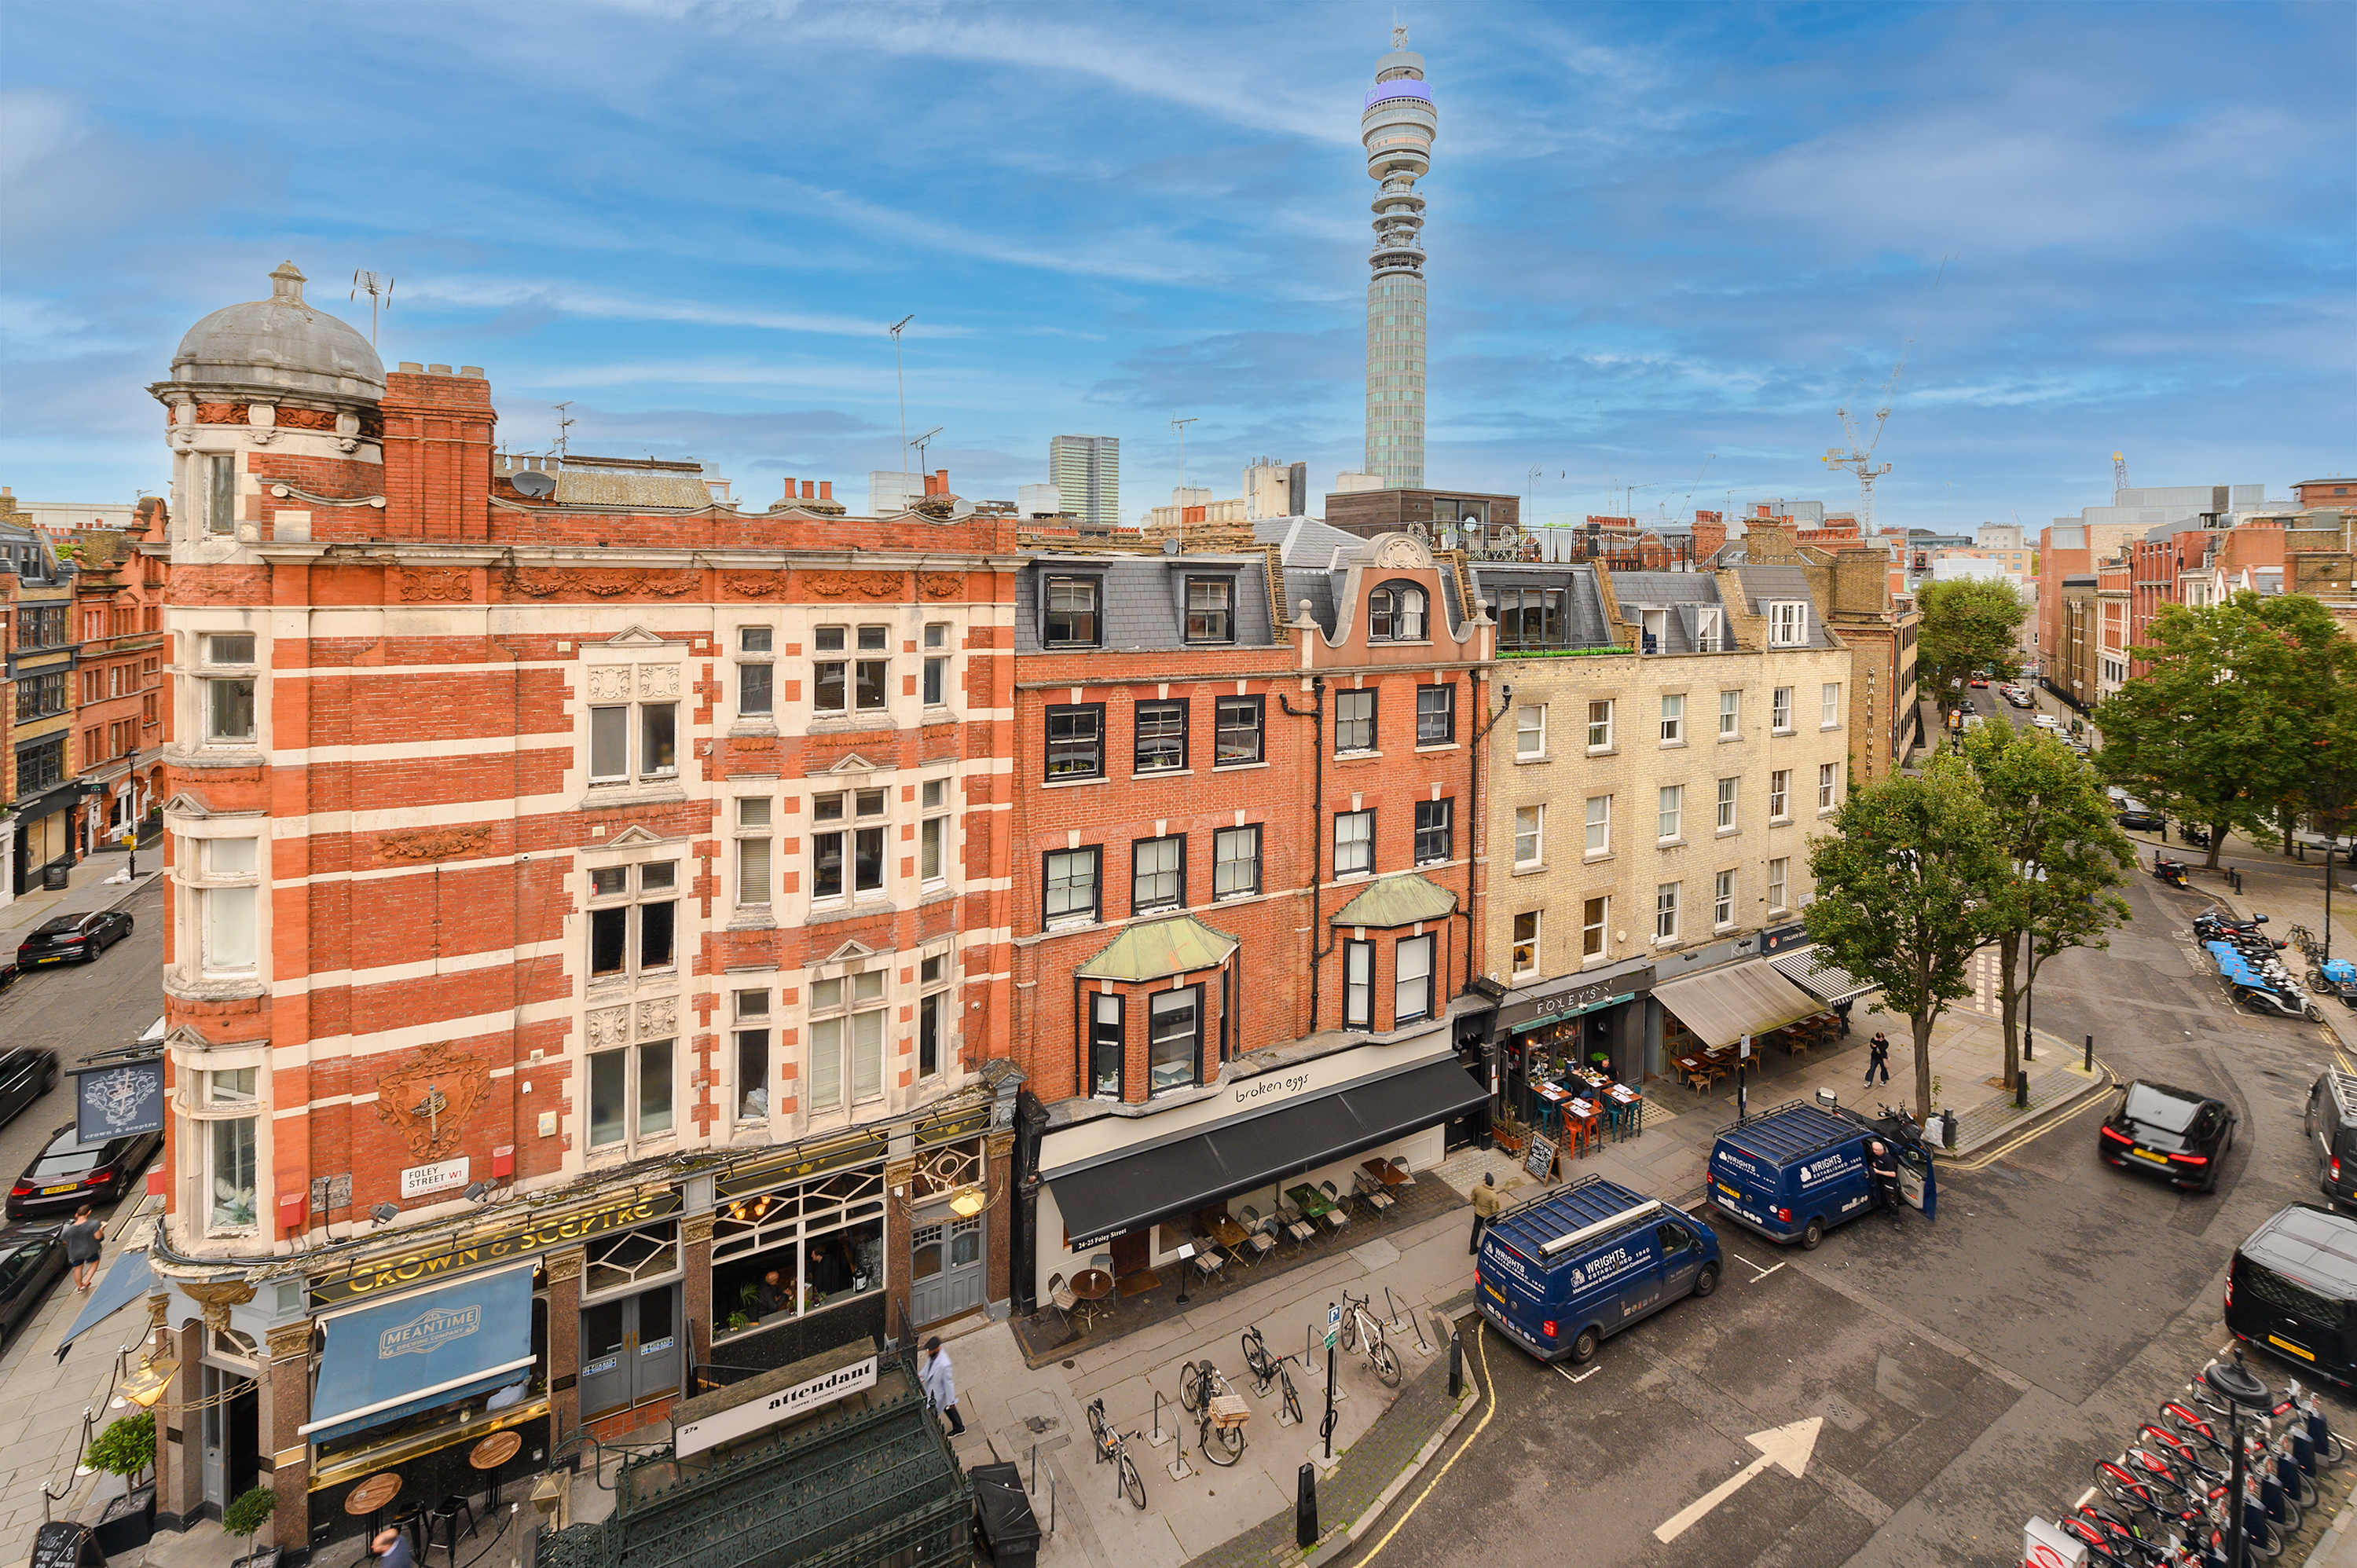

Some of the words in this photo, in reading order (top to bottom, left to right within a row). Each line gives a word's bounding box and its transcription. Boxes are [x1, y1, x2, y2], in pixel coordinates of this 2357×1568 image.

[1782, 932, 1800, 943] ITALIAN
[1537, 989, 1596, 1015] FOLEY'S
[1235, 1081, 1281, 1103] broken
[1285, 1073, 1309, 1092] eggs
[84, 1131, 112, 1140] crown
[125, 1122, 157, 1131] sceptre
[409, 1166, 438, 1179] FOLEY
[1726, 1153, 1757, 1172] WRIGHTS
[1809, 1154, 1842, 1174] WRIGHTS
[1813, 1162, 1848, 1178] ESTABLISHED
[409, 1174, 445, 1189] STREET
[449, 1170, 463, 1179] W1
[349, 1242, 478, 1292] CROWN
[489, 1234, 511, 1256] &
[520, 1196, 654, 1250] SCEPTRE
[1094, 1234, 1110, 1244] Foley
[1110, 1228, 1127, 1238] Street
[1495, 1247, 1525, 1273] WRIGHTS
[1585, 1247, 1626, 1274] WRIGHTS
[1588, 1255, 1633, 1281] ESTABLIHED
[1635, 1247, 1650, 1258] 1940
[1572, 1280, 1599, 1295] Maintenance
[387, 1310, 475, 1346] MEANTIME
[768, 1362, 871, 1410] attendant
[791, 1400, 810, 1409] COFFEE
[814, 1391, 834, 1401] KITCHEN
[838, 1381, 863, 1392] ROASTERY
[684, 1426, 698, 1435] 27a
